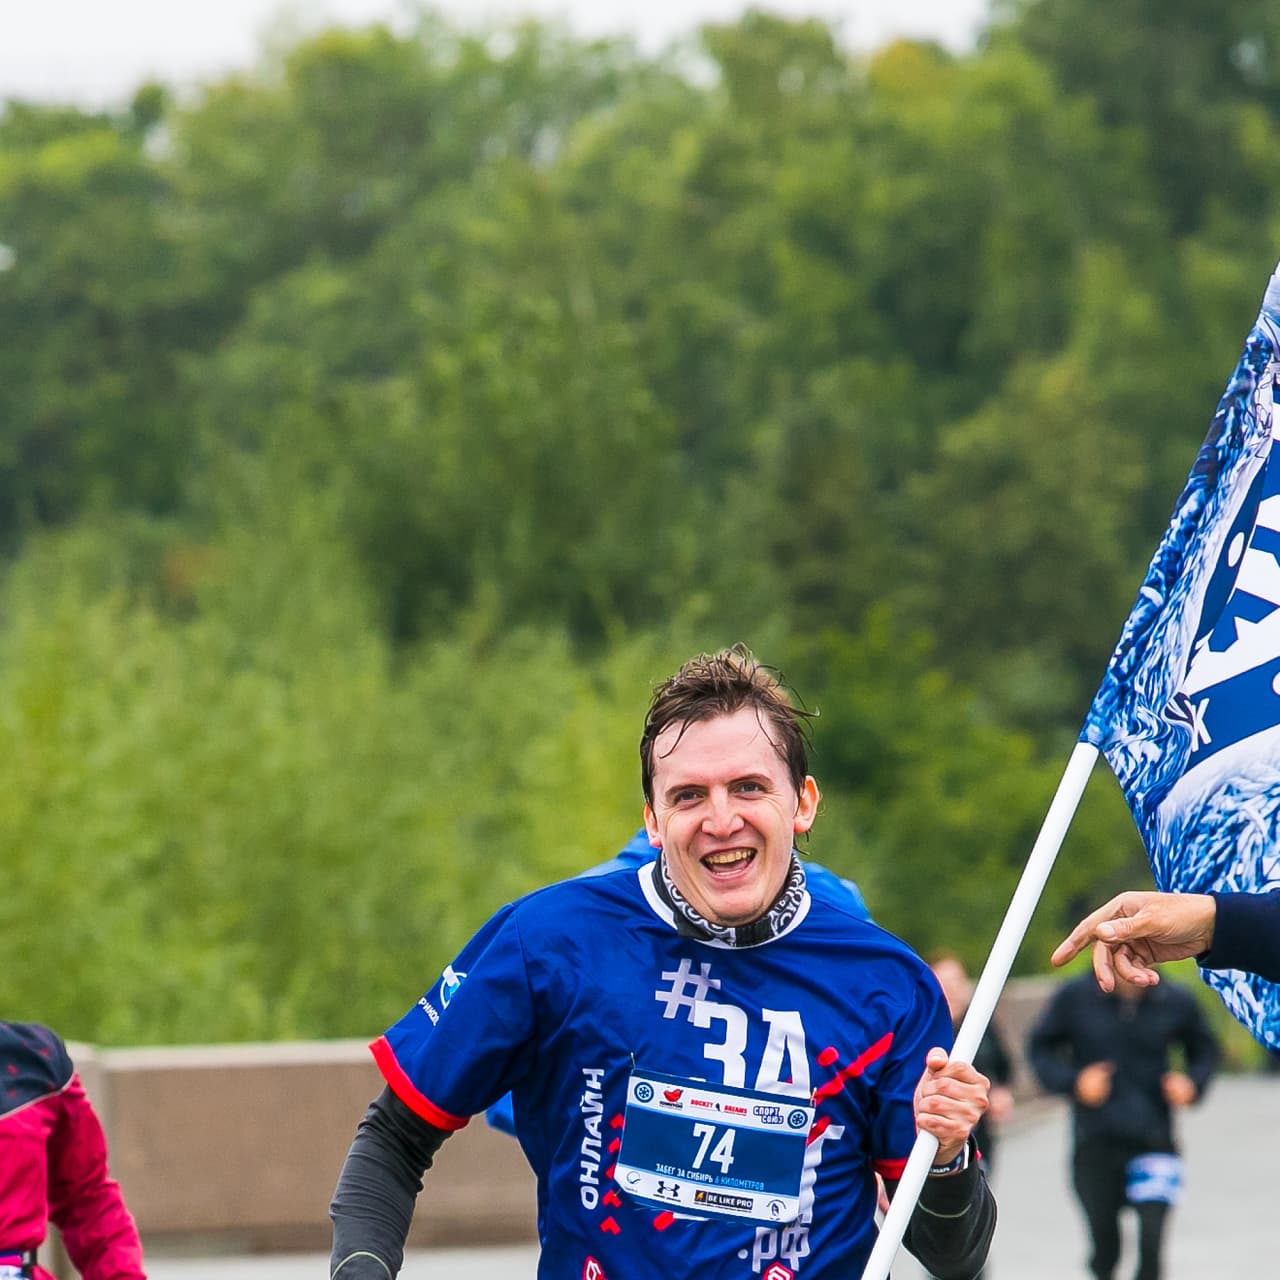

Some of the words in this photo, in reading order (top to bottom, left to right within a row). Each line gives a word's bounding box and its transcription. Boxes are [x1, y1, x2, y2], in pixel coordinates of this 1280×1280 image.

[753, 1104, 780, 1117] СПОРТ
[579, 1068, 605, 1211] ОНЛАЙН
[692, 1122, 737, 1175] 74
[655, 1162, 675, 1175] ЗАБЕГ
[677, 1168, 686, 1178] ЗА
[686, 1170, 714, 1183] СИБИРЬ
[720, 1176, 765, 1191] КИЛОМЕТРОВ
[707, 1194, 720, 1205] BE
[720, 1196, 736, 1207] LIKE
[735, 1198, 753, 1209] PRO
